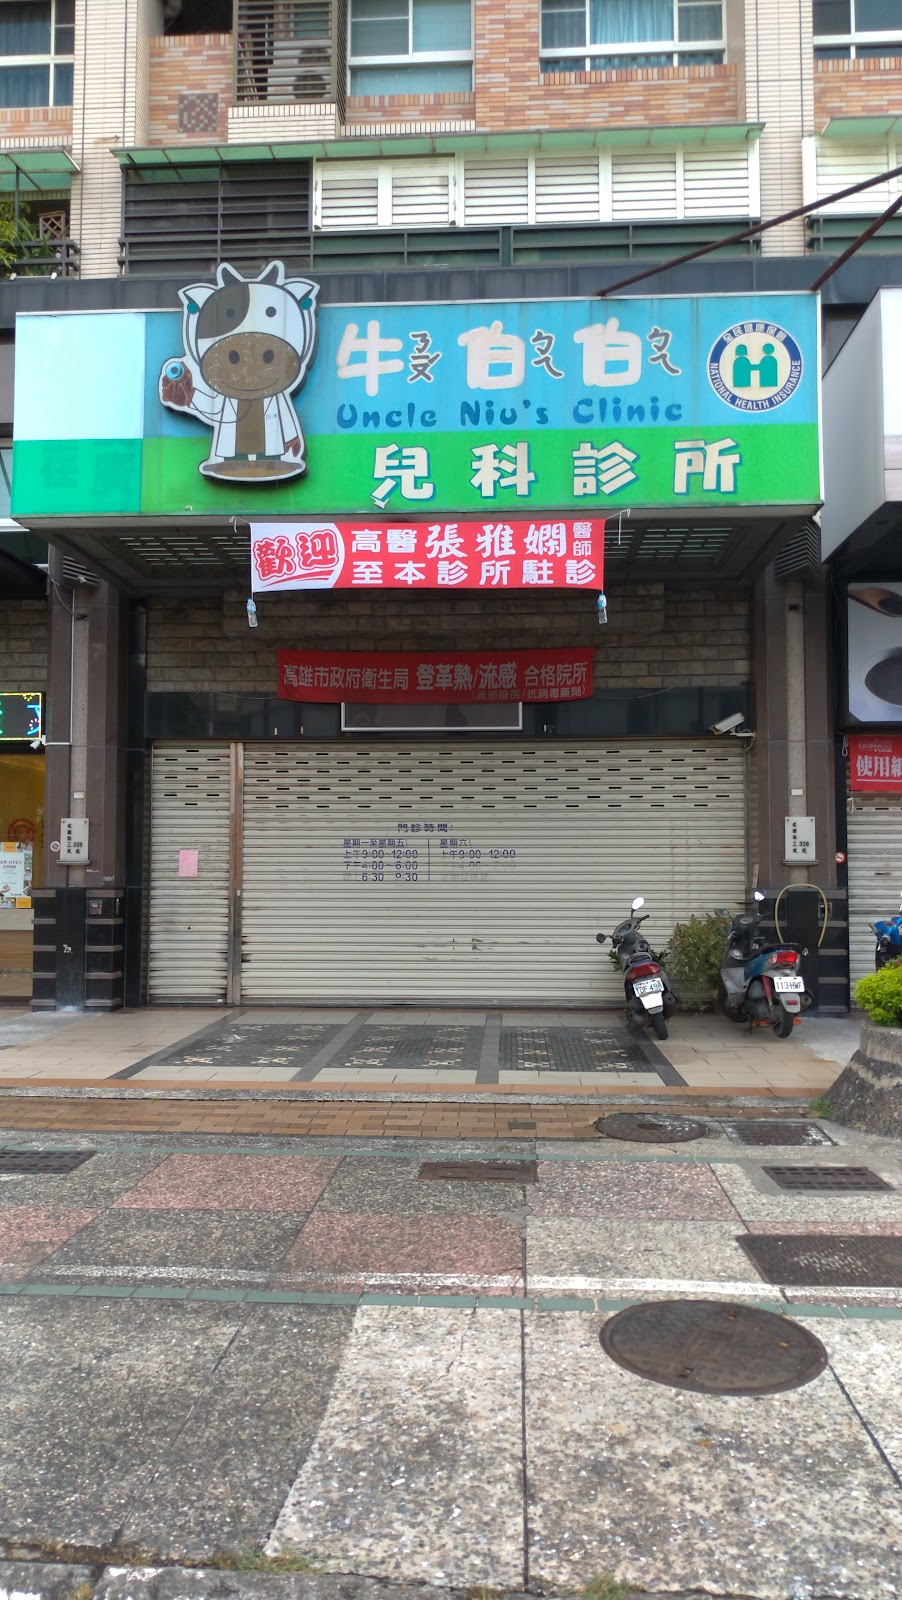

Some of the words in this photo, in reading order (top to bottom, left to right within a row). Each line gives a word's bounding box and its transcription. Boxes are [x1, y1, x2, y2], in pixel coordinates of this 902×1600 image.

[709, 362, 734, 403] NATIONAL
[734, 397, 770, 411] HEALTH
[771, 360, 802, 406] INSURANCE
[336, 402, 437, 429] Uncle
[460, 399, 549, 426] Niu's
[572, 396, 683, 424] Clinic
[370, 438, 742, 508] 兒科診所
[253, 529, 339, 581] 歡迎
[351, 559, 596, 586] 至本診所駐診
[283, 664, 409, 690] 高雄市政府衛生局
[523, 661, 588, 688] 合格院所
